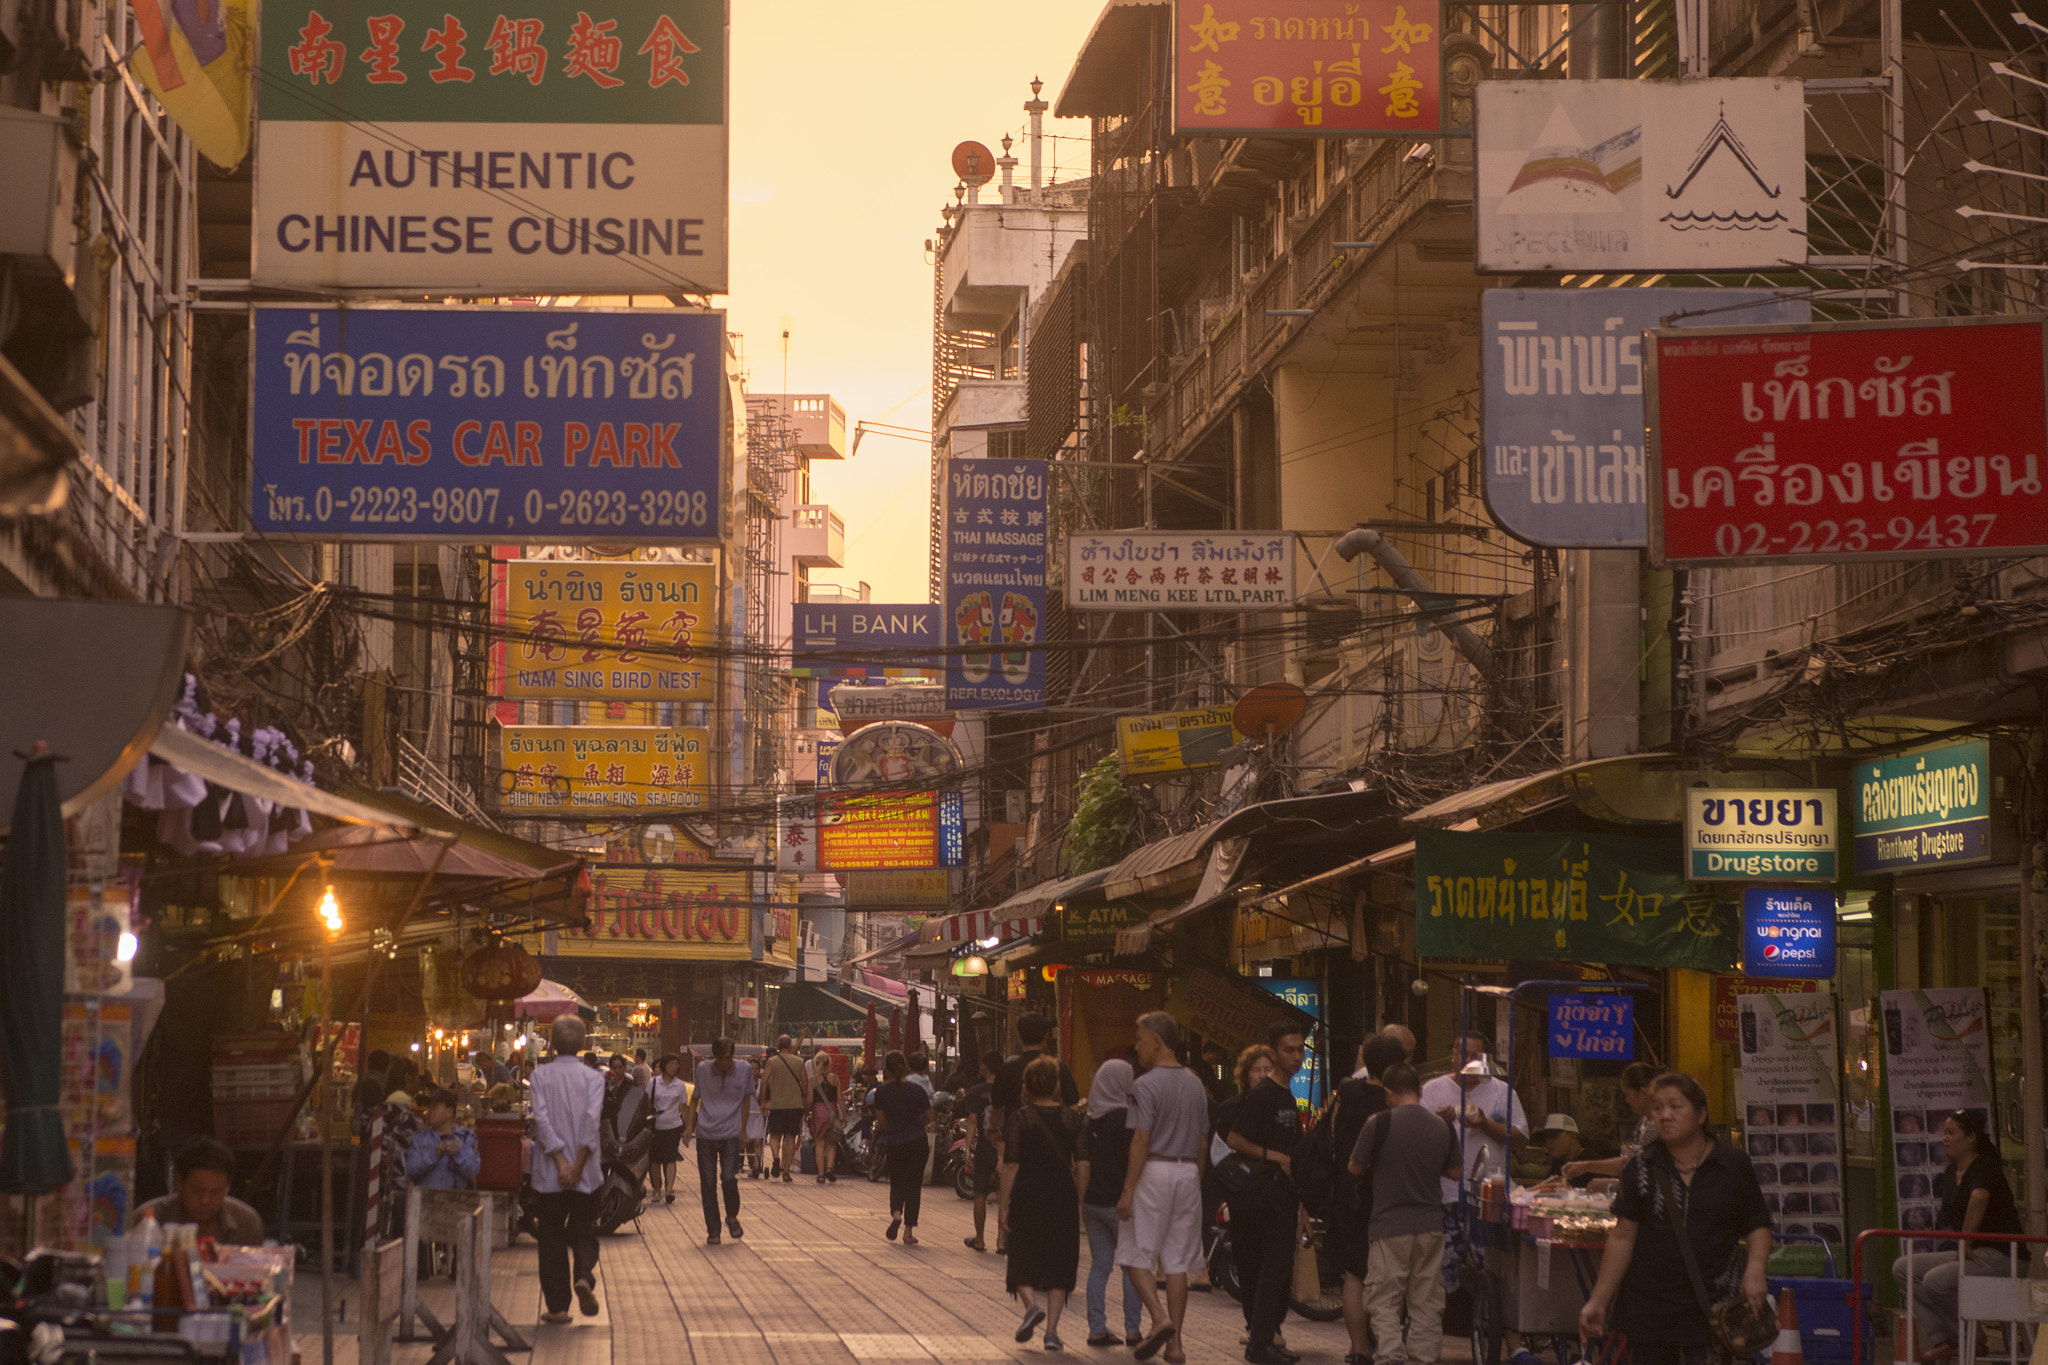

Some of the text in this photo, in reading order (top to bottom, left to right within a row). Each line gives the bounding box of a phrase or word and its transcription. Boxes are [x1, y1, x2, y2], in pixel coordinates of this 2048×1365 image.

[1249, 3, 1370, 41] ราดหน้า
[288, 10, 701, 88] 南星生鍋麵食
[1251, 43, 1362, 125] อยู่อี่
[348, 150, 635, 189] AUTHENTIC
[277, 214, 704, 256] CHINESE CUISINE
[283, 313, 696, 400] ที่จอดรถ เท็กซัส
[1741, 355, 1956, 422] เท็กซัส
[293, 418, 682, 469] TEXAS CAR PARK
[952, 464, 1043, 500] หัตถชัย
[1666, 432, 2042, 509] เครื่องเขียน
[525, 490, 707, 526] 0-2623-3298
[953, 507, 1044, 526] 古式按摩
[952, 531, 1044, 546] THAI MASSAGE
[1715, 513, 1998, 557] 02-223-9437
[1080, 538, 1180, 561] ห้างใบชา
[524, 569, 603, 602] นำซิง
[951, 568, 1043, 587] นวดแผนไทย
[1080, 589, 1108, 602] LIM
[1114, 589, 1160, 602] MENG
[1167, 589, 1198, 602] KEE
[804, 614, 929, 634] LH BANK
[518, 670, 702, 690] NAM SING BIRD NEST
[949, 687, 1040, 702] REFLEXOLOGY
[1129, 711, 1232, 733] แฟ้ม ตราช้าง
[572, 735, 647, 761] หูฉลาม
[654, 732, 701, 761] ซีฟู้ด
[650, 763, 693, 789] 海鮮
[508, 792, 535, 806] BIRD
[537, 791, 566, 807] NEST
[572, 791, 610, 807] SHARK
[612, 791, 638, 807] FINS
[1862, 757, 1979, 822] คลังยาเหรียญทอง
[1702, 797, 1824, 827] ขายยา
[1697, 830, 1829, 846] โดยเภสัชกรปริญญา
[1877, 831, 1964, 862] Rianthong Drugstore
[1707, 853, 1819, 876] Drugstore
[1087, 907, 1128, 922] ATM
[1600, 870, 1722, 937] 如意
[1765, 897, 1813, 911] ร้านเด็ด
[1757, 926, 1822, 940] wongnai
[1781, 948, 1816, 960] pepsi
[1096, 973, 1152, 985] MASSAGE
[1742, 1064, 1833, 1075] Shampoo & Hair Spray
[1751, 1053, 1823, 1064] Deep-sea Mineral
[1897, 1054, 1976, 1065] Deep-sea Mineral
[1888, 1067, 1931, 1077] Shampoo
[1942, 1066, 1959, 1074] Hair
[1963, 1066, 1986, 1076] Spray
